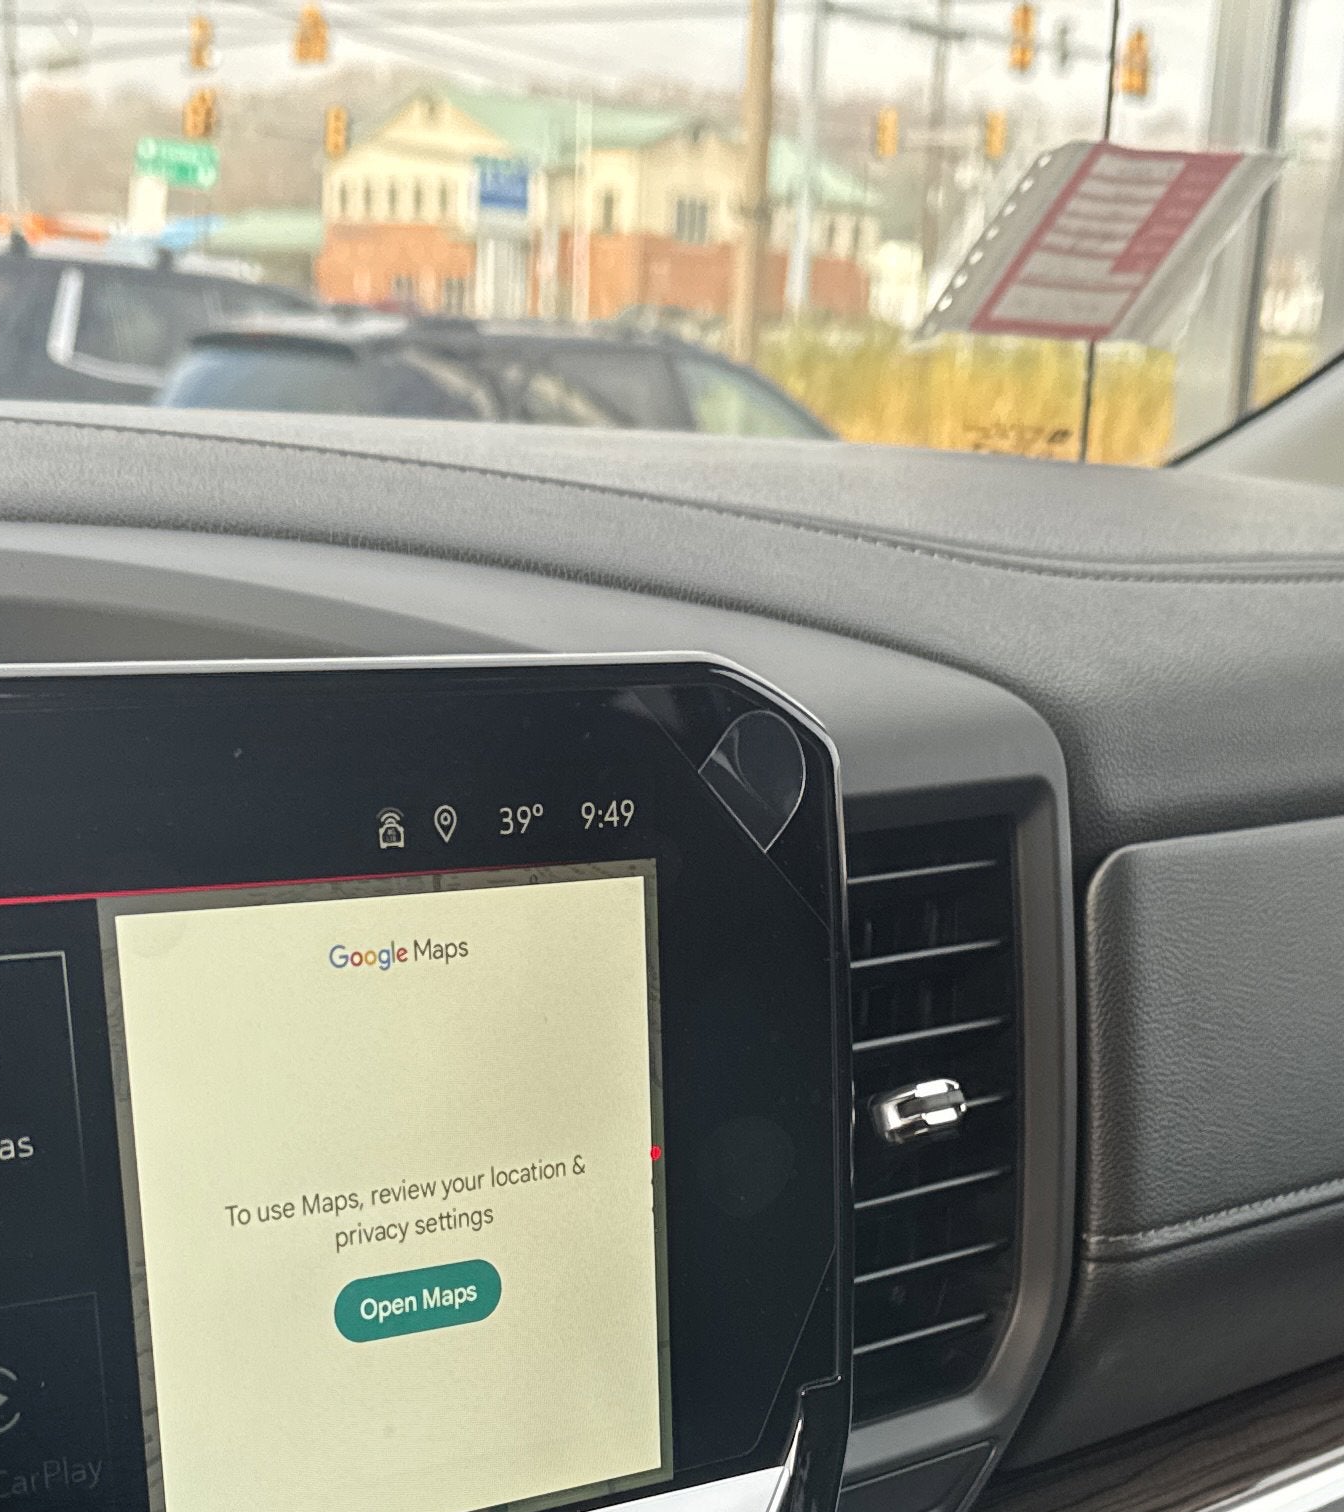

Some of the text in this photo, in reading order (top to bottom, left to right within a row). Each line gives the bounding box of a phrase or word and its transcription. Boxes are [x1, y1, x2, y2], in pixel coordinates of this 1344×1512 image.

[580, 799, 635, 830] 9:49
[328, 938, 469, 971] Google Maps
[225, 1154, 587, 1227] To use Maps, review your location &
[335, 1205, 494, 1253] privacy settings
[359, 1283, 478, 1324] Open Maps
